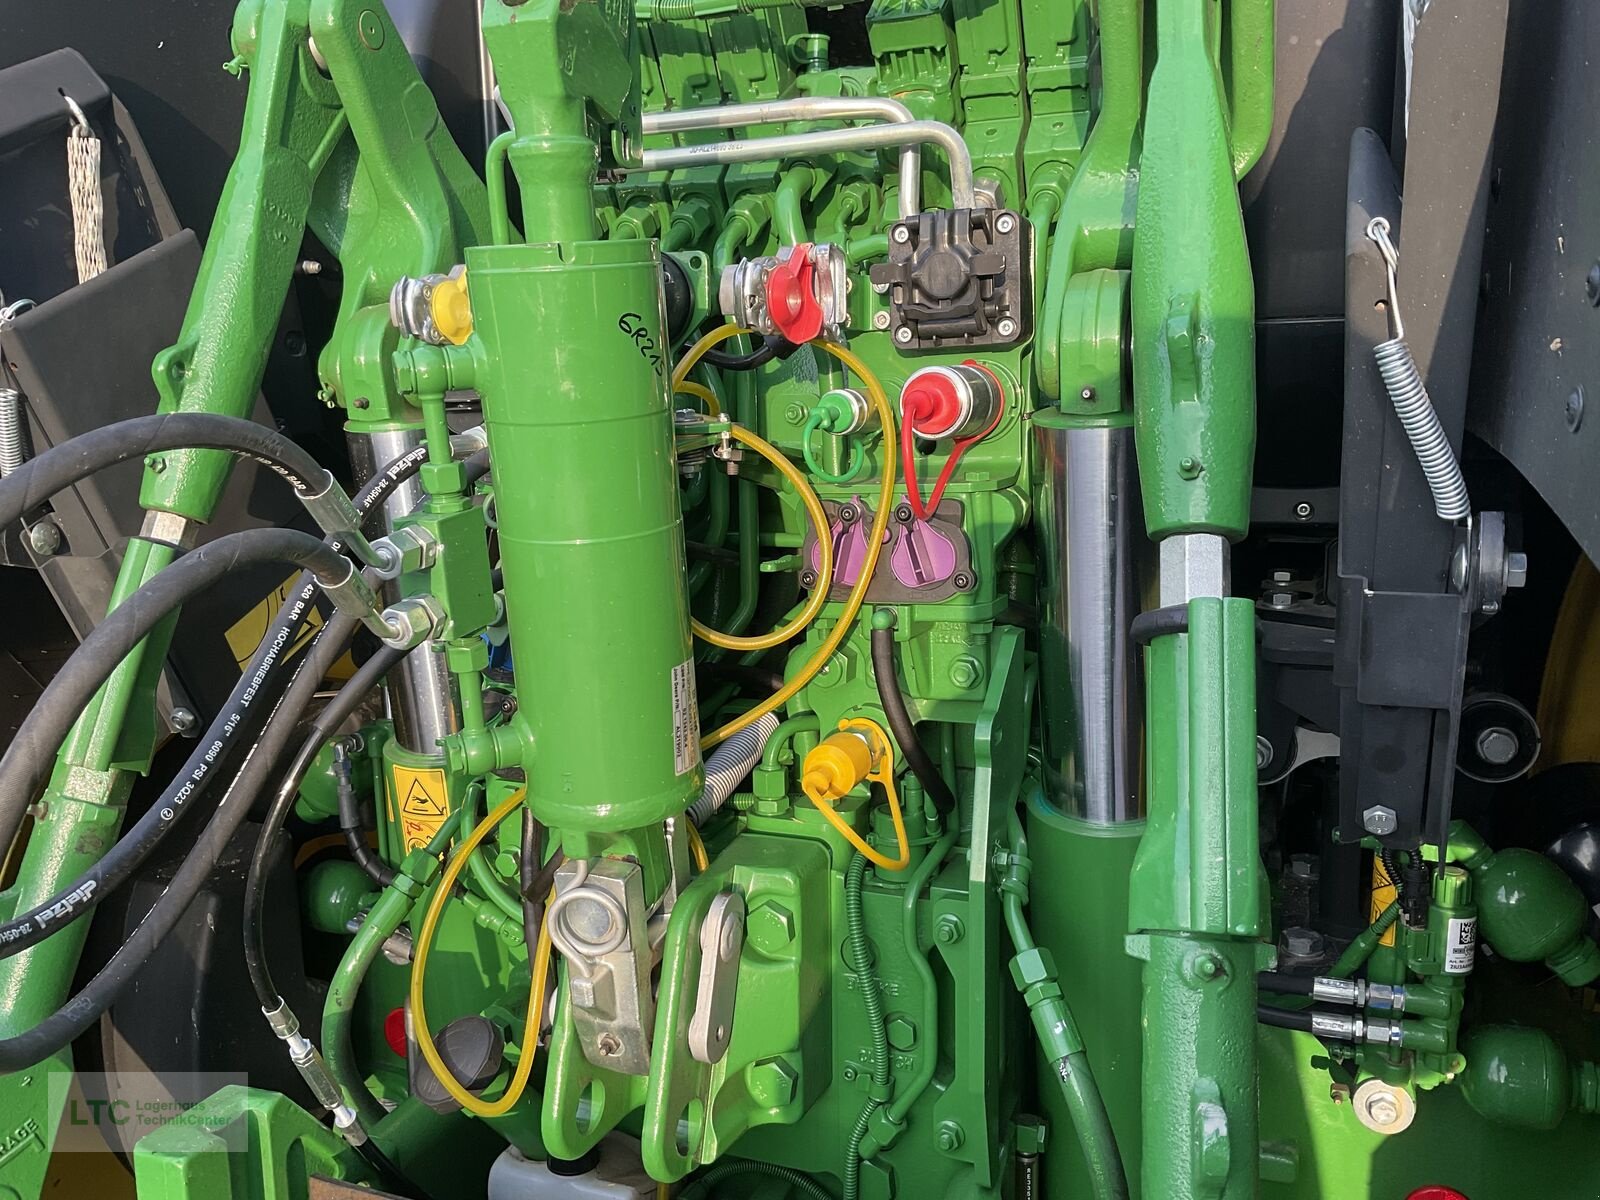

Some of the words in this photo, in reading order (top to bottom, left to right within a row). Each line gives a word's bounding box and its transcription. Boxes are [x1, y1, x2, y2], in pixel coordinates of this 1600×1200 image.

[386, 447, 427, 481] dietzel
[301, 583, 314, 600] 420
[288, 600, 305, 621] BAR
[240, 626, 291, 708] HOCHABRIEBFEST
[204, 740, 223, 762] 6090
[191, 763, 208, 781] PSI
[174, 781, 195, 804] 3Q23
[34, 880, 97, 929] dietzel
